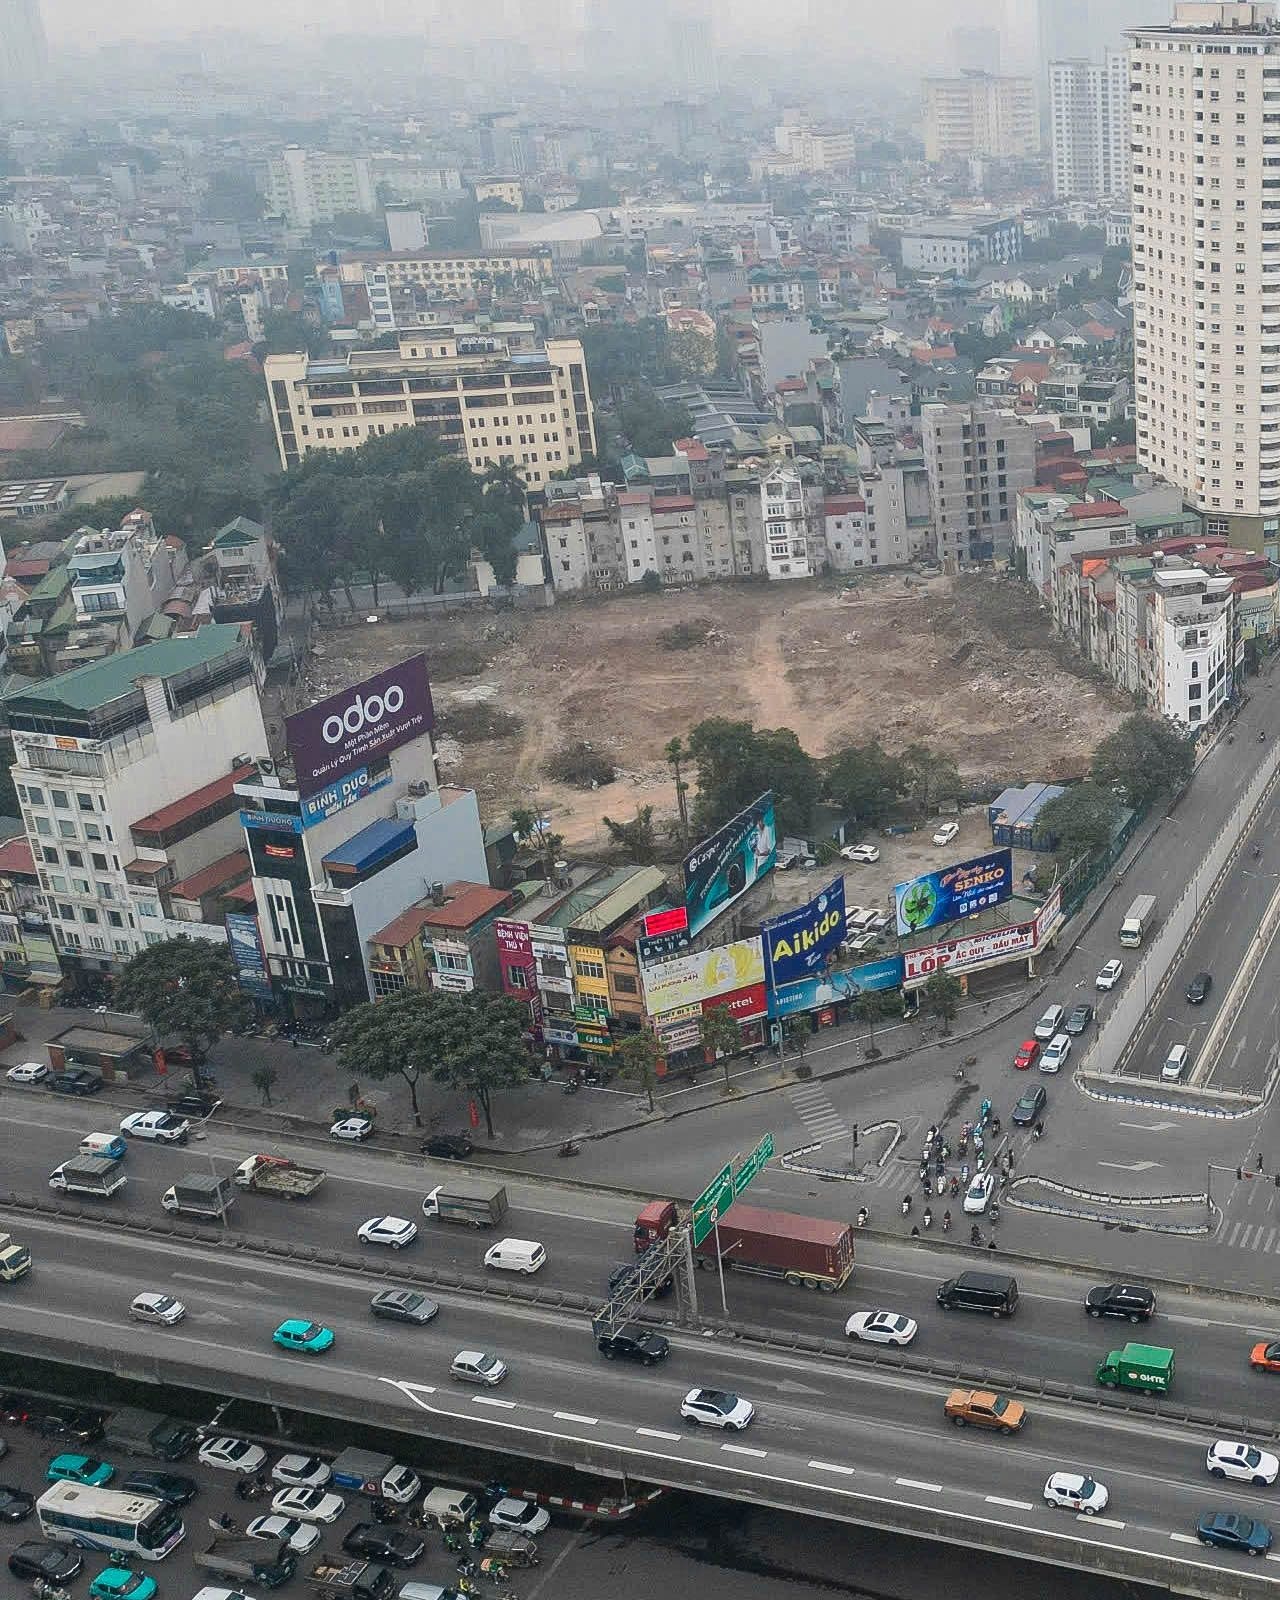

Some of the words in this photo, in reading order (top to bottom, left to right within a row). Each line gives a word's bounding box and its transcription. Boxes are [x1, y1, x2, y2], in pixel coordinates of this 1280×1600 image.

[322, 685, 404, 744] odoo
[954, 867, 1005, 892] SENKO
[773, 910, 840, 962] Aikido
[683, 973, 699, 983] 24H
